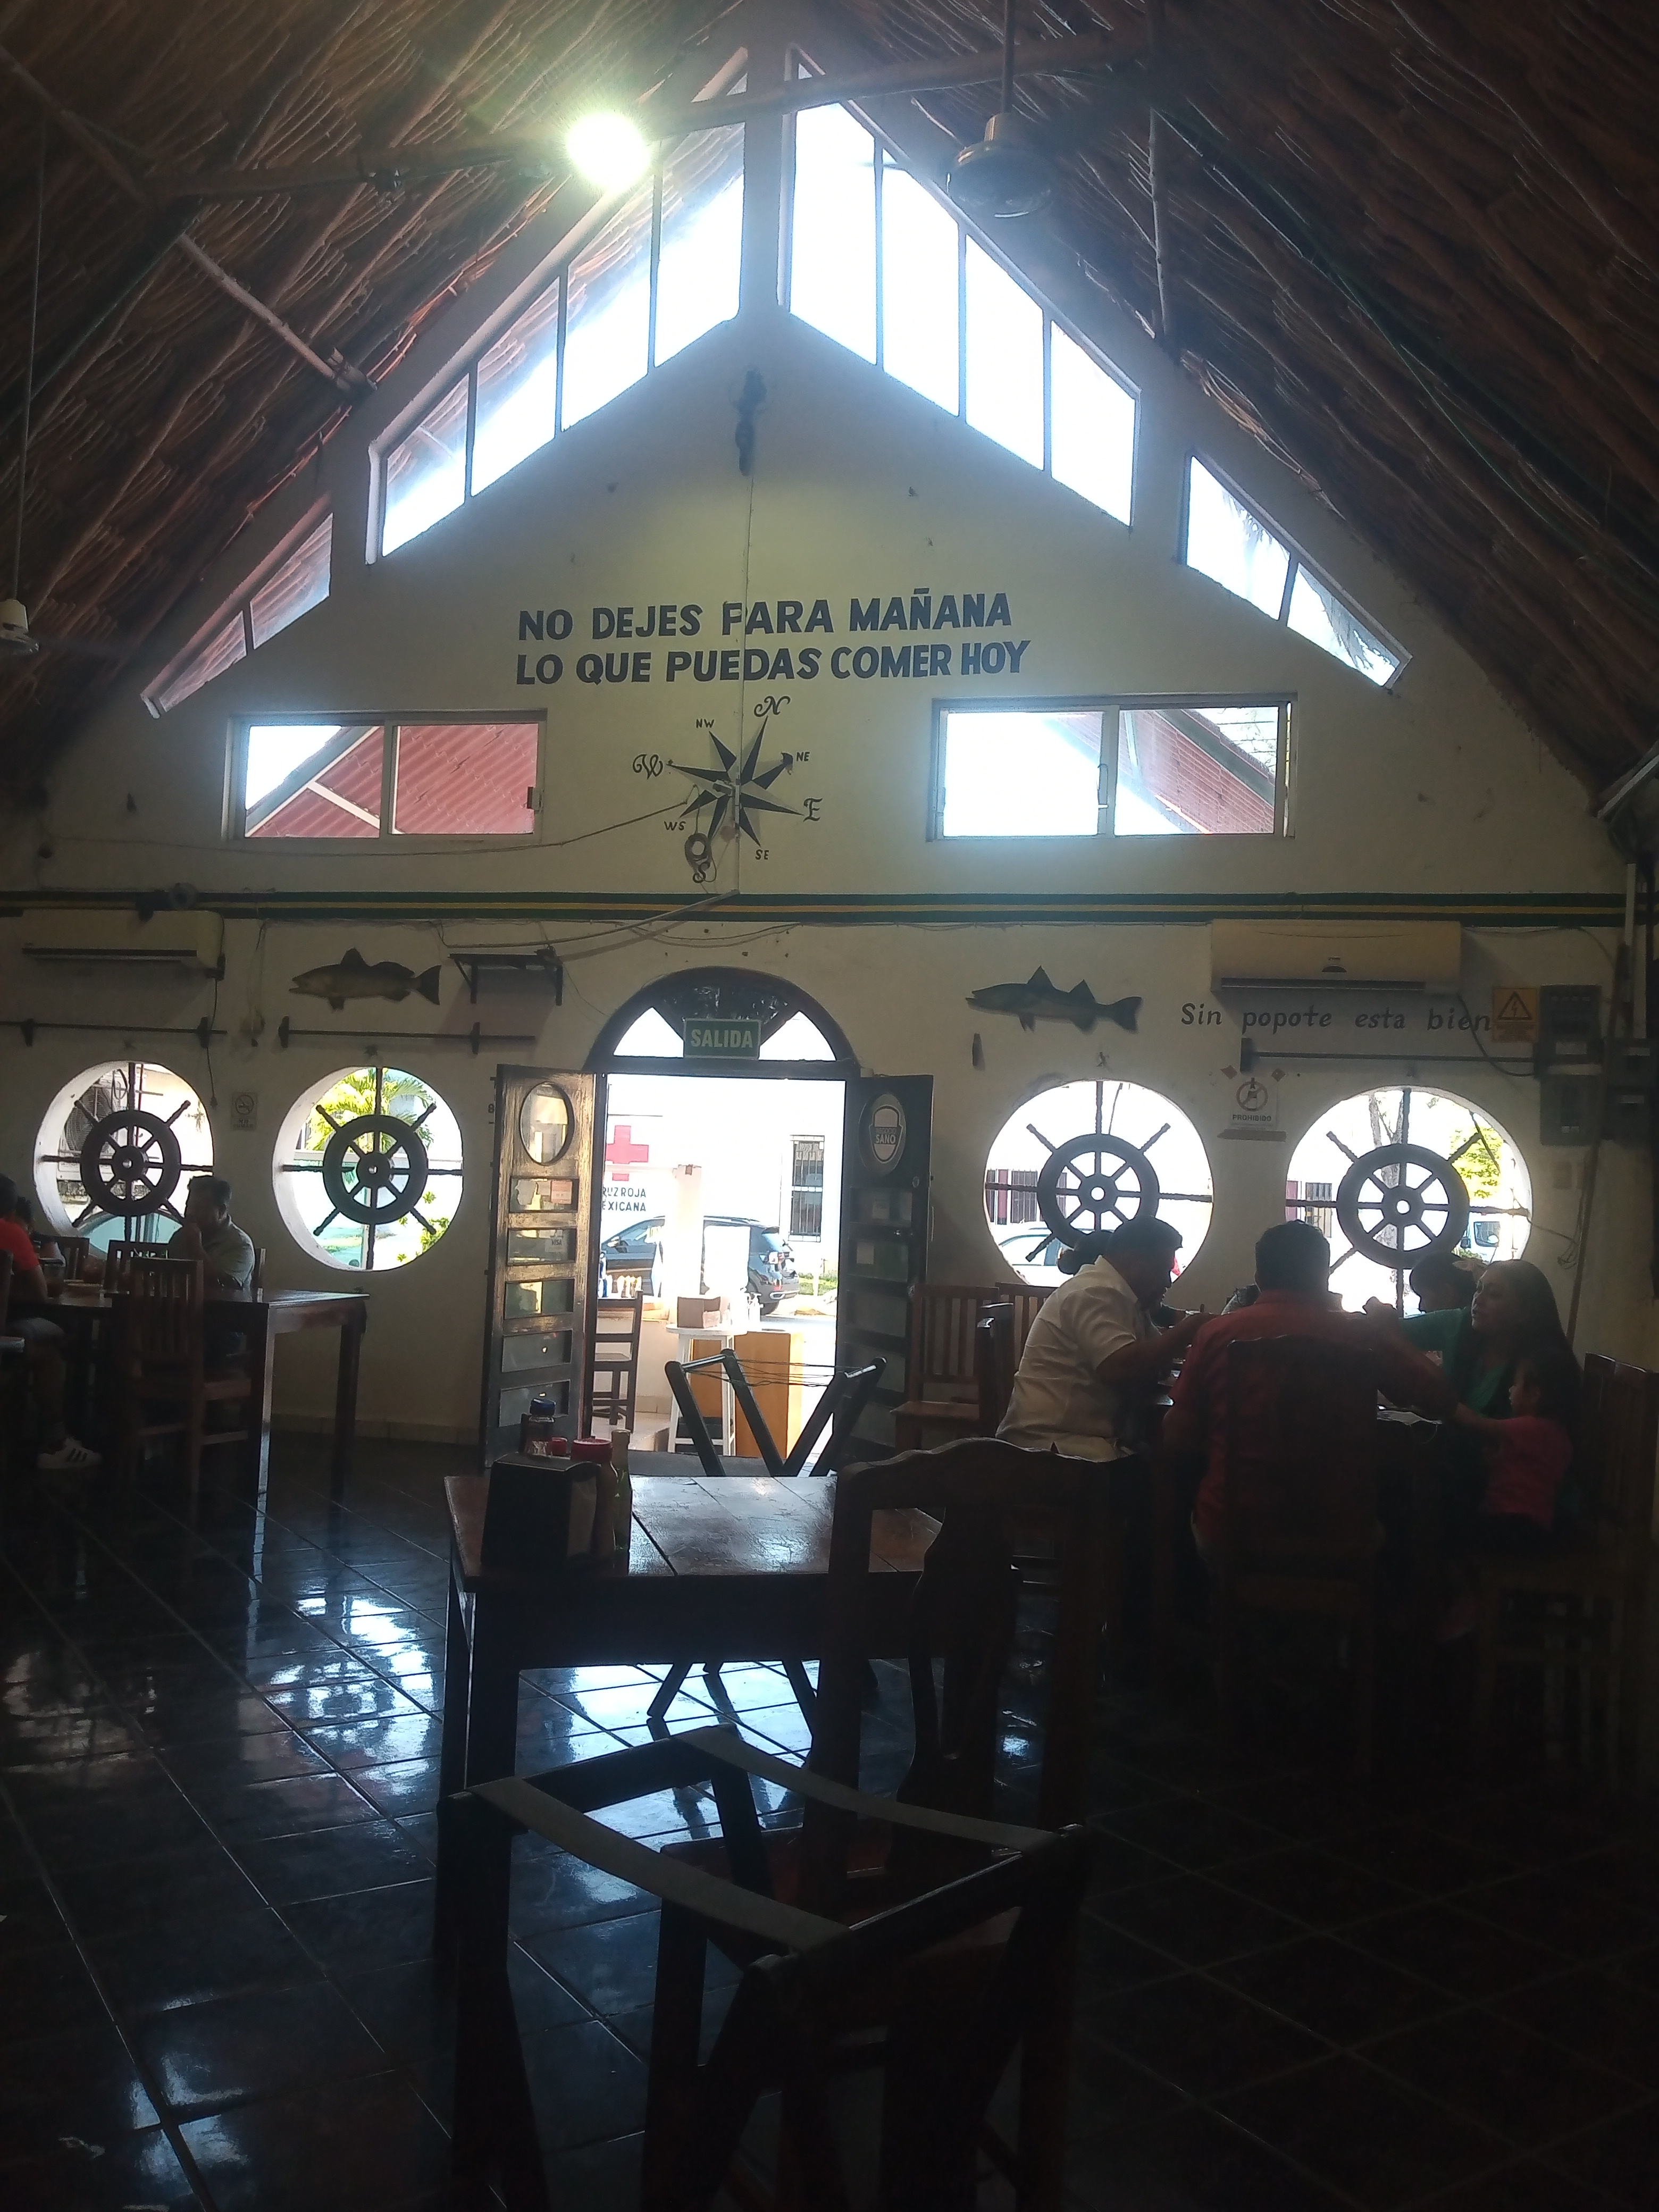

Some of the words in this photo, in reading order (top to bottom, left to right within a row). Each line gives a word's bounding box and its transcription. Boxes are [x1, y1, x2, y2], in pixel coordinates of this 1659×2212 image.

[518, 609, 573, 640] NO
[592, 604, 703, 640] DEJES
[850, 588, 1012, 632] MAÑANA
[516, 653, 563, 685] LO
[576, 652, 651, 685] QUE
[666, 647, 822, 682] PUEDAS
[831, 643, 952, 679] COMER
[961, 640, 1031, 675] HOY
[754, 696, 791, 717] N
[696, 718, 715, 728] NW
[796, 751, 810, 761] NE
[632, 754, 663, 780] W
[803, 798, 823, 823] E
[664, 821, 686, 831] WS
[755, 849, 769, 860] SE
[692, 861, 710, 883] S
[1181, 1002, 1222, 1026] Sin
[1241, 1004, 1331, 1035] popote
[1354, 1007, 1405, 1029] esta
[1427, 1007, 1491, 1031] bien
[691, 1029, 753, 1048] SALIDA
[876, 1134, 895, 1144] SANO
[621, 1188, 646, 1197] ROJA
